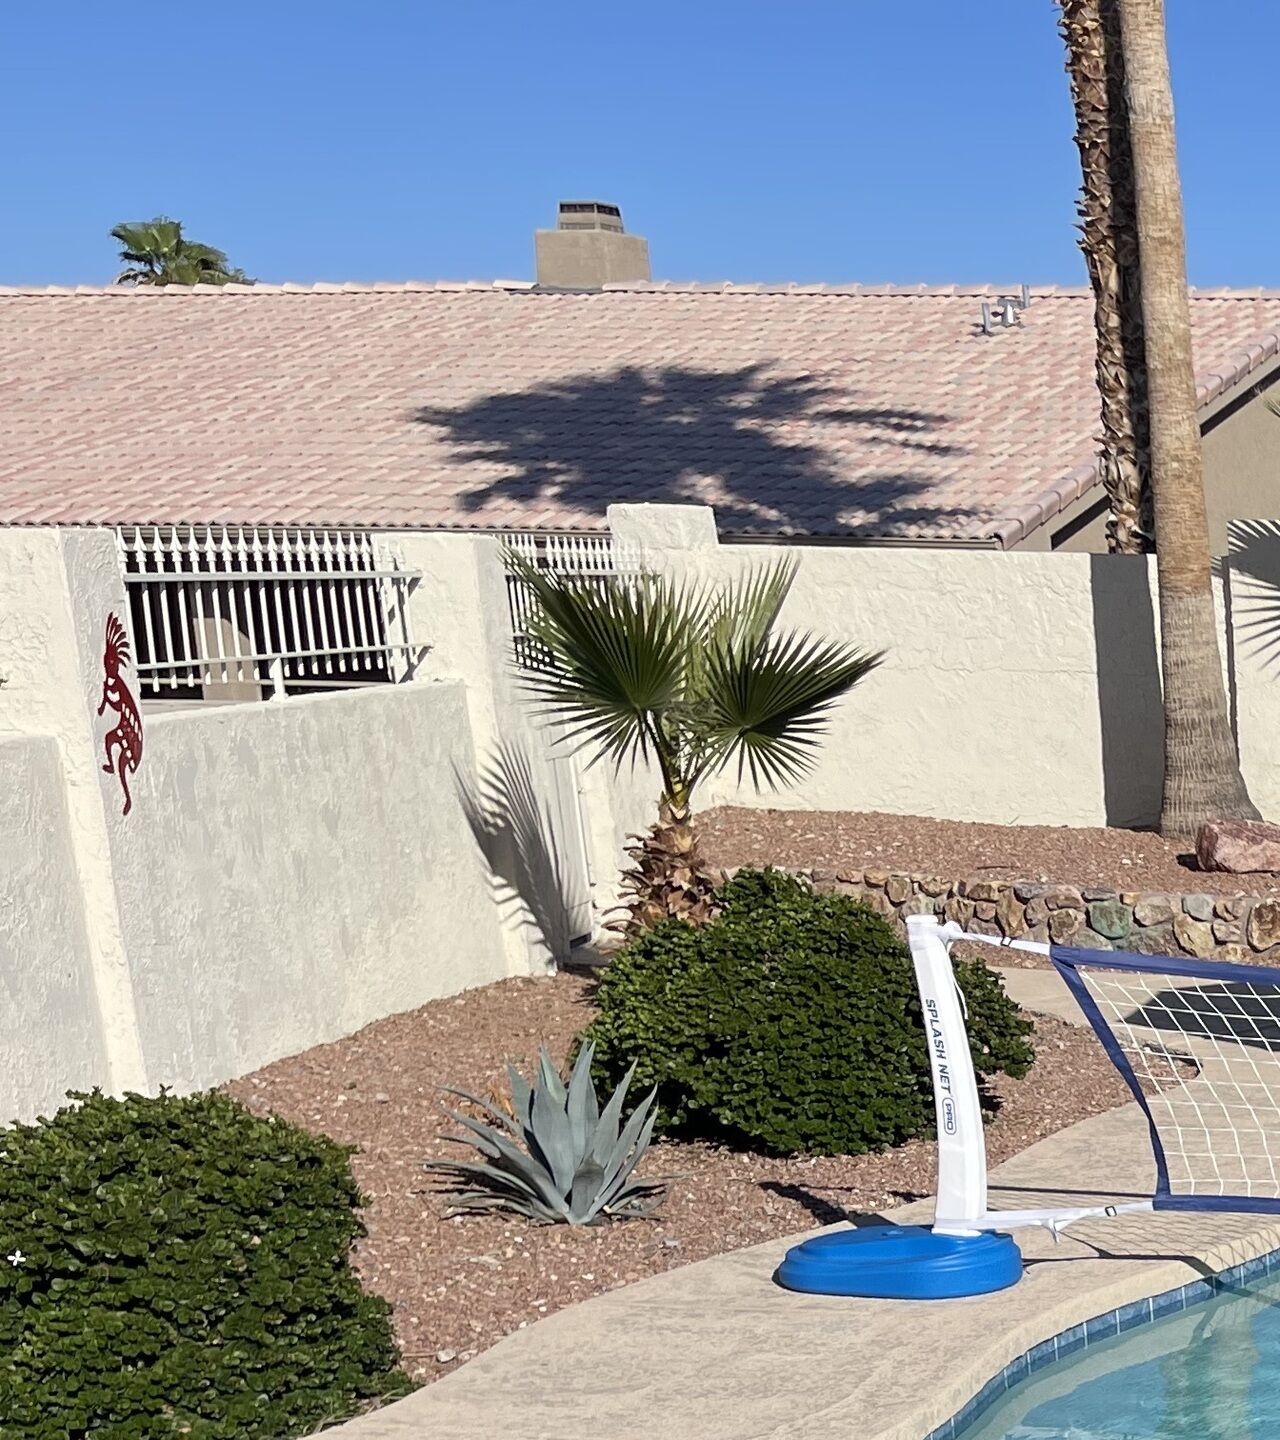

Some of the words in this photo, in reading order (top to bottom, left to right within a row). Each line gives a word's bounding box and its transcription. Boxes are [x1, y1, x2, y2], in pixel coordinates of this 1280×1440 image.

[925, 998, 947, 1060] SPLASH
[938, 1063, 951, 1094] NET
[945, 1103, 954, 1131] PRO
